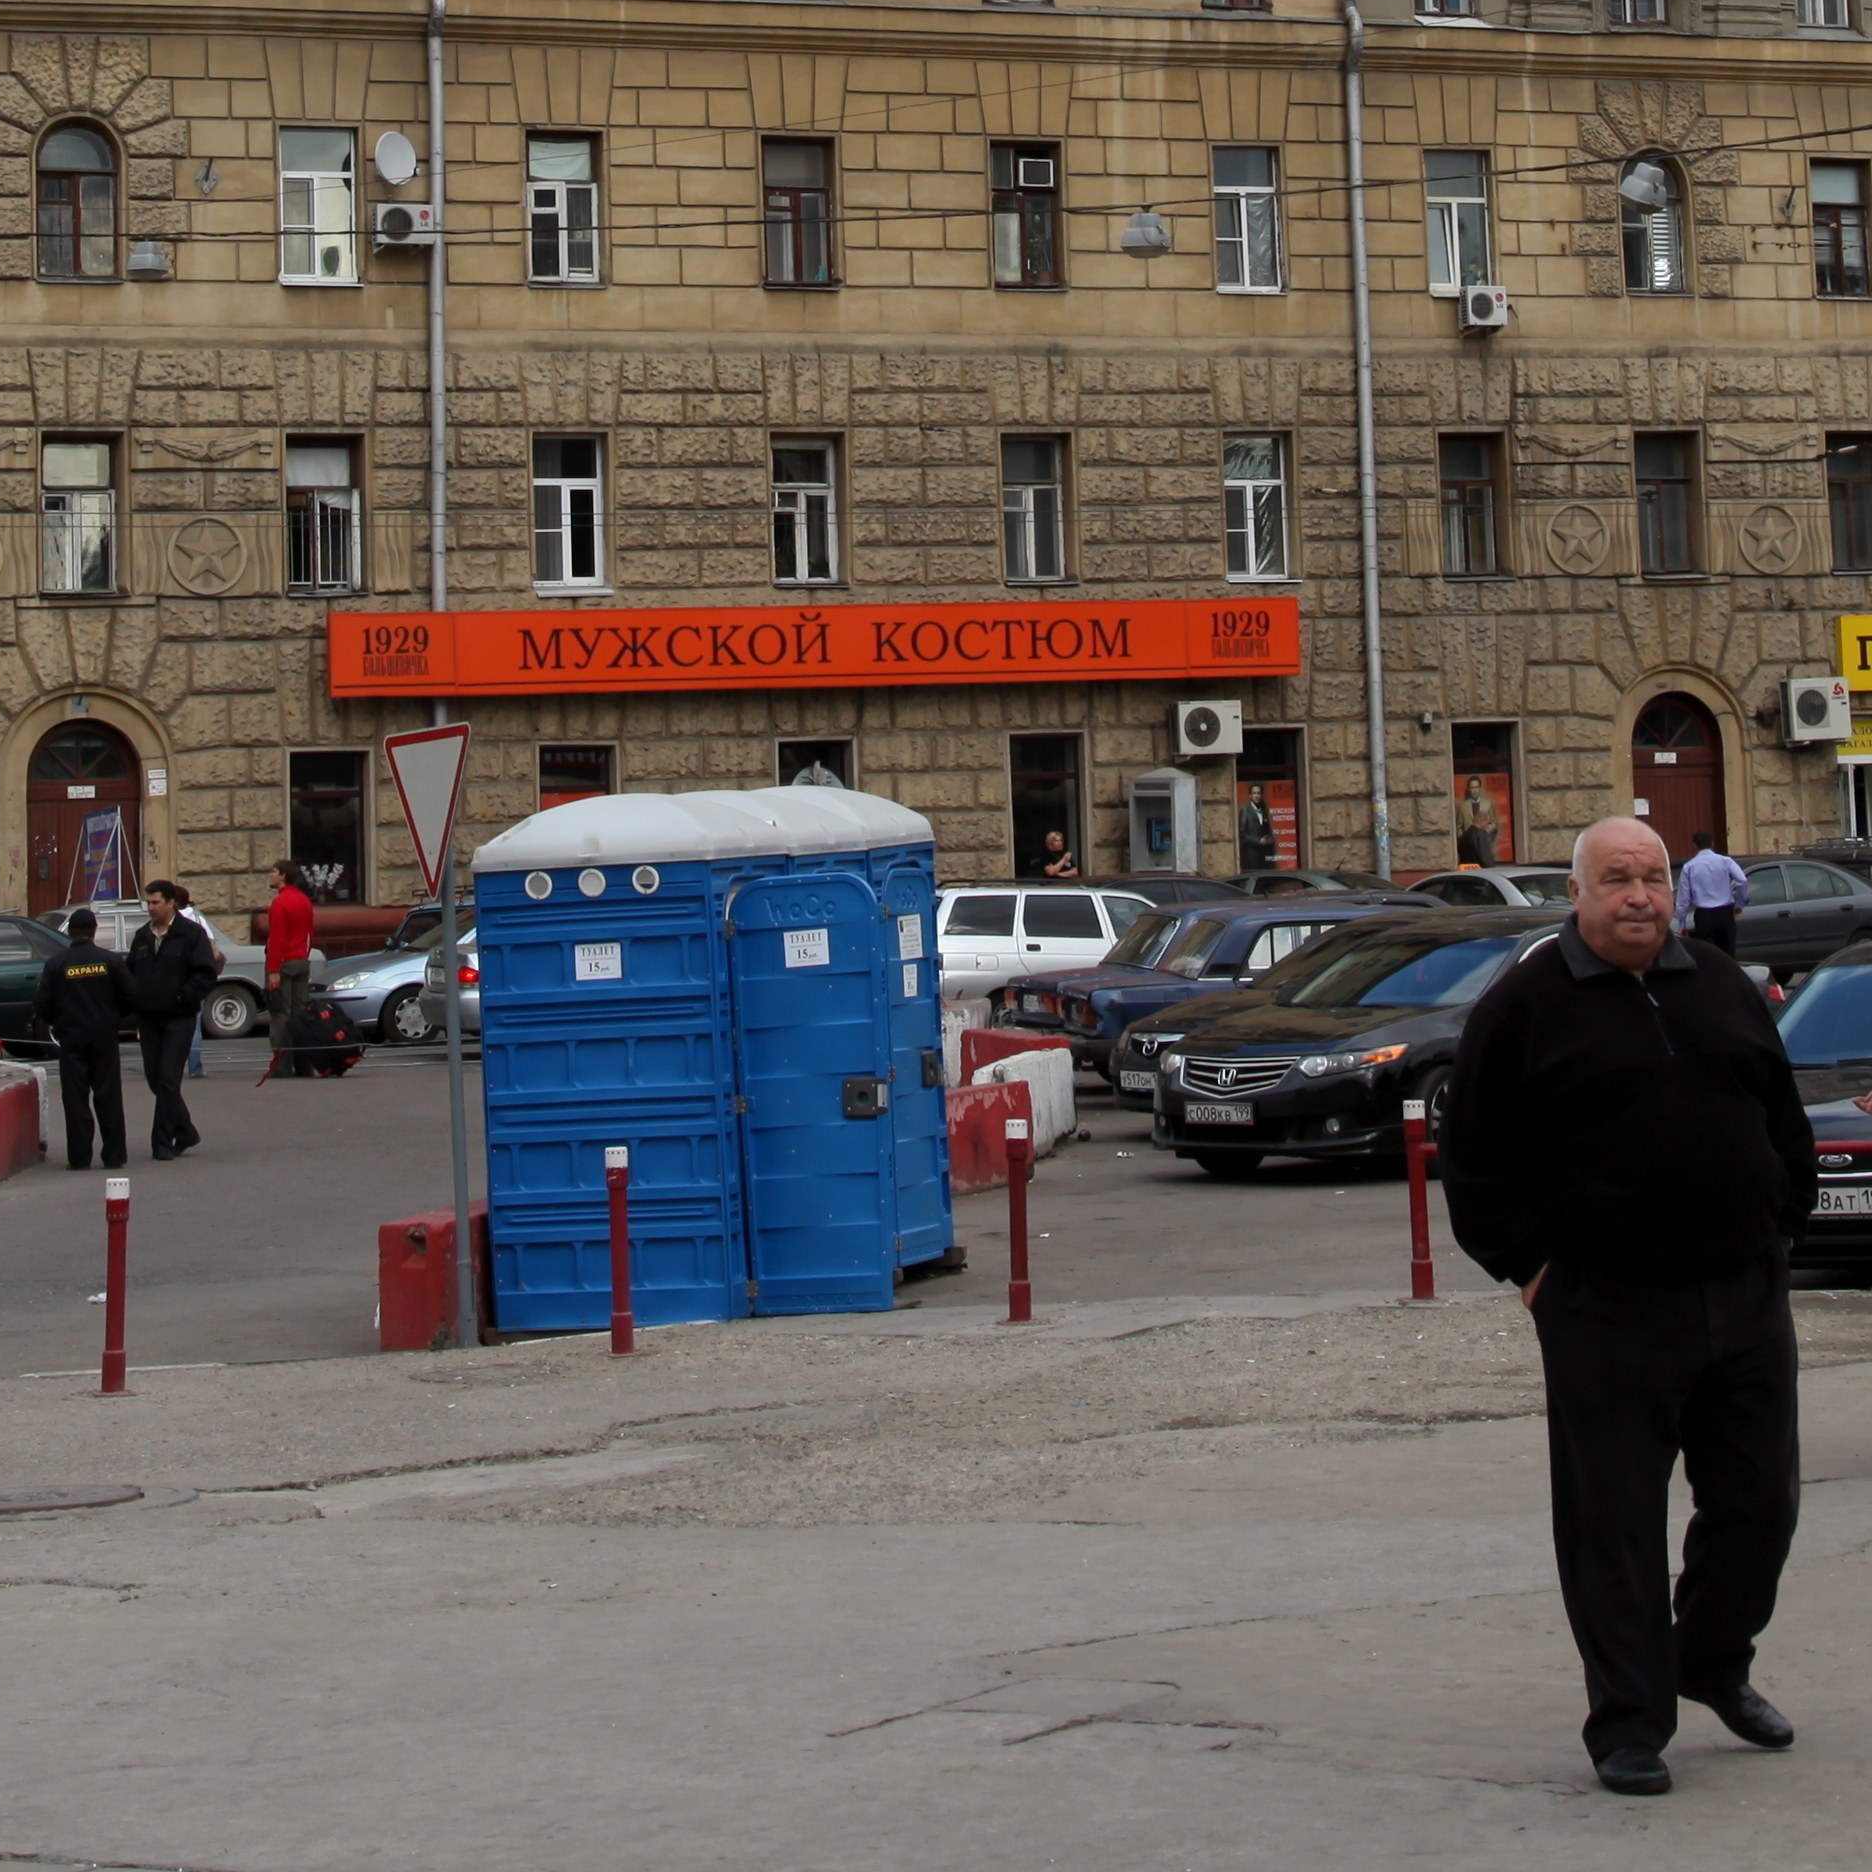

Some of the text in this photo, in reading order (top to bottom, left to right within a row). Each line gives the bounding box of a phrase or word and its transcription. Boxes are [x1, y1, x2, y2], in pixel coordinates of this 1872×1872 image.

[1211, 610, 1271, 638] 1929
[362, 625, 430, 655] 1929
[518, 612, 1133, 671] МУЖСКОЙ КОСТЮМ
[362, 655, 430, 677] БОЛЬШЕВИЧКА
[790, 932, 822, 943] ТУАЛЕТ
[581, 946, 614, 957] ТУАЛЕТ
[797, 948, 808, 959] 15
[67, 965, 106, 976] ОХРАНА
[589, 962, 600, 973] 15
[1189, 1104, 1250, 1123] С008КВ 199
